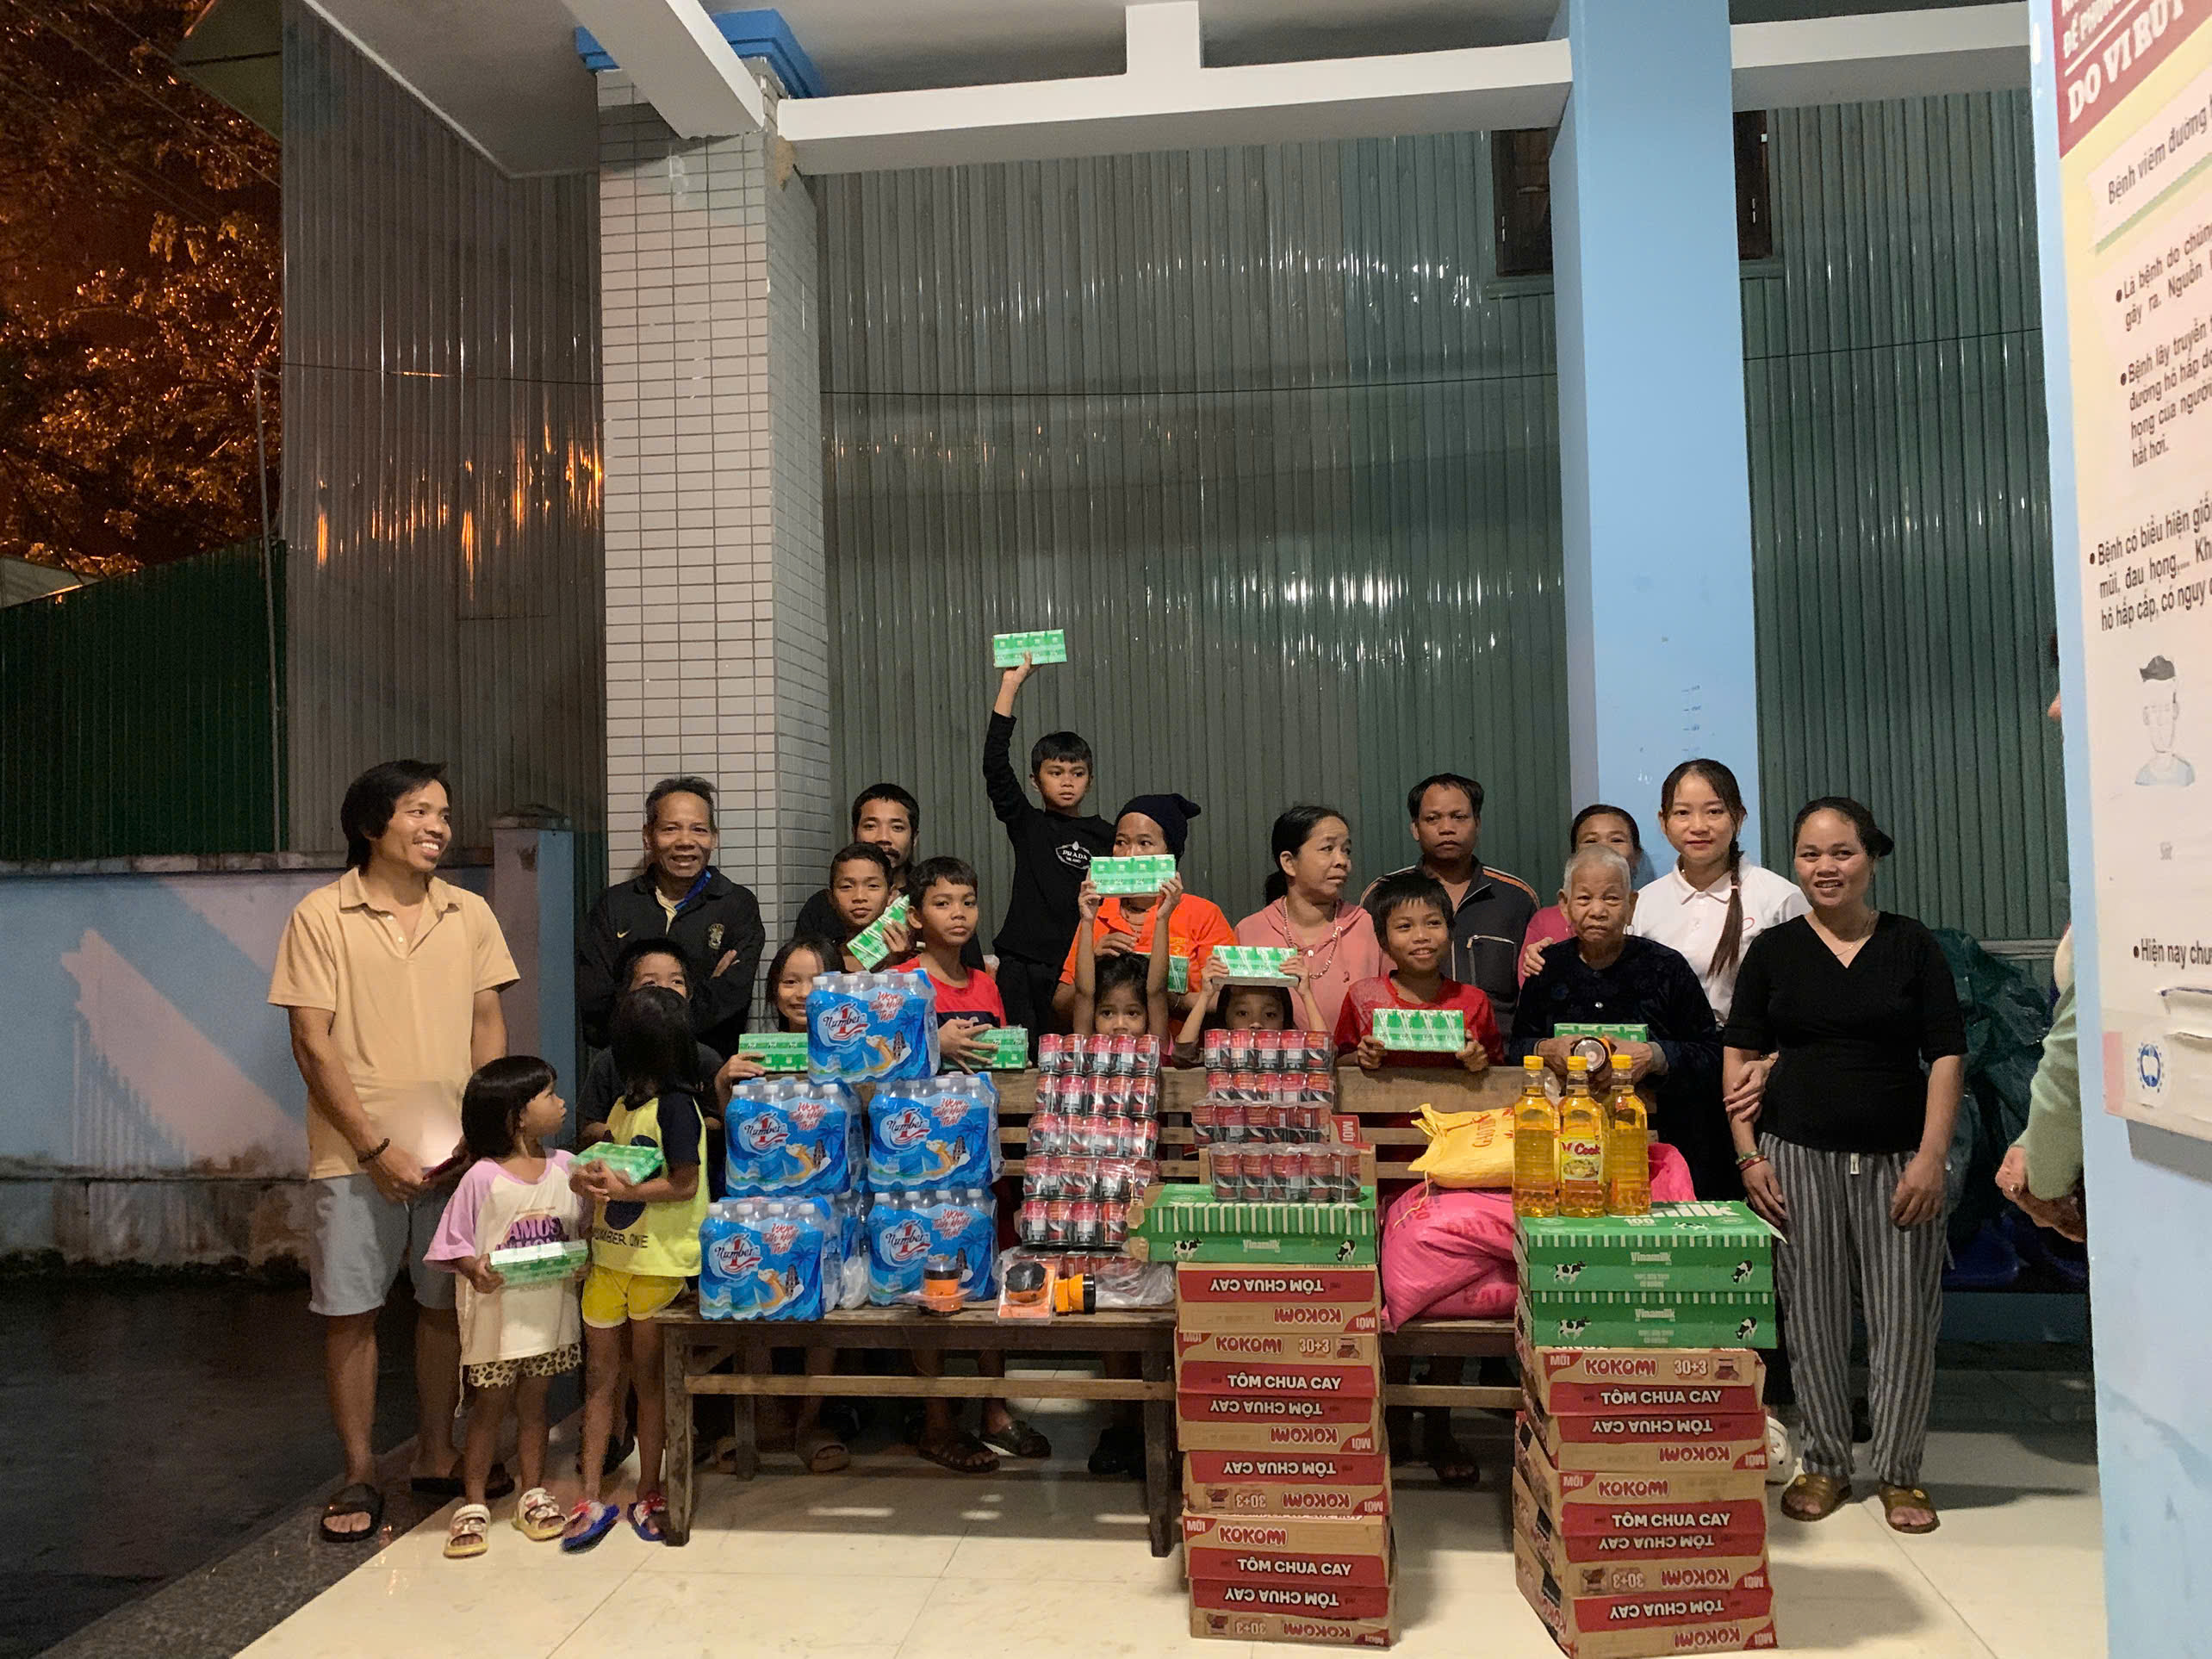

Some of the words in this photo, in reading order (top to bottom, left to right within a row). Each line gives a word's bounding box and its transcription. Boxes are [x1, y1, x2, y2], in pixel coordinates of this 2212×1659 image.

[2067, 63, 2102, 123] DO
[2103, 28, 2132, 84] VI
[2109, 165, 2136, 205] Bệnh
[2137, 143, 2166, 179] viêm
[2123, 276, 2135, 299] Là
[2138, 257, 2164, 289] bệnh
[2166, 246, 2180, 269] do
[2125, 303, 2142, 332] gây
[2148, 294, 2162, 312] ra.
[2167, 258, 2203, 298] Nguồn
[2128, 352, 2153, 384] Bệnh
[2172, 317, 2207, 358] truyền
[2129, 382, 2162, 412] đường
[2164, 366, 2178, 392] hô
[2149, 433, 2170, 459] hơi.
[2097, 535, 2123, 569] Bệnh
[2125, 527, 2138, 555] có
[2140, 514, 2163, 549] biểu
[2165, 509, 2190, 540] hiện
[2125, 565, 2144, 590] đau
[2101, 606, 2114, 631] hô
[2116, 594, 2134, 630] hấp
[2136, 587, 2159, 622] cấp,
[2161, 583, 2175, 612] có
[2178, 579, 2206, 612] nguy
[1062, 849, 1088, 861] PRADA
[2141, 938, 2165, 967] Hiện
[2167, 943, 2187, 970] nay
[823, 1011, 861, 1029] Number
[744, 1121, 780, 1136] Number
[886, 1117, 923, 1132] Number
[885, 1229, 923, 1246] Number
[714, 1243, 753, 1260] Number
[1631, 1252, 1672, 1264] Vinamilk
[1210, 1278, 1241, 1291] CAY
[1244, 1278, 1288, 1292] CHUA
[1289, 1278, 1324, 1296] TÔM
[1274, 1308, 1343, 1324] KOKOMI
[1635, 1308, 1675, 1320] Vinamilk
[1215, 1336, 1283, 1355] KOKOMI
[1299, 1338, 1331, 1354] 30+3
[1584, 1358, 1658, 1376] KOKOMI
[1674, 1358, 1708, 1376] 30+3
[1227, 1372, 1262, 1388] TÔM
[1264, 1375, 1308, 1389] CHUA
[1311, 1376, 1341, 1390] CAY
[1600, 1389, 1637, 1405] TÔM
[1639, 1389, 1687, 1404] CHUA
[1689, 1389, 1722, 1403] CAY
[1210, 1400, 1240, 1413] CAY
[1243, 1401, 1287, 1414] CHUA
[1289, 1402, 1323, 1419] TÔM
[1592, 1420, 1625, 1433] CAY
[1630, 1420, 1674, 1433] CHUA
[1676, 1419, 1713, 1435] TÔM
[1270, 1426, 1338, 1445] KOKOMI
[1659, 1446, 1730, 1463] KOKOMI
[1223, 1461, 1253, 1474] CAY
[1257, 1461, 1300, 1474] CHUA
[1302, 1462, 1337, 1478] TÔM
[1598, 1480, 1669, 1498] KOKOMI
[1235, 1494, 1266, 1508] 30+3
[1283, 1492, 1351, 1510] KOKOMI
[1612, 1511, 1648, 1527] TÔM
[1650, 1513, 1696, 1527] CHUA
[1699, 1513, 1730, 1526] CAY
[1218, 1525, 1288, 1545] KOKOMI
[1634, 1536, 1677, 1550] CHUA
[1680, 1534, 1715, 1550] TÔM
[1598, 1537, 1631, 1550] CAY
[1237, 1556, 1271, 1572] TÔM
[1274, 1561, 1318, 1575] CHUA
[1320, 1563, 1352, 1576] CAY
[1612, 1572, 1643, 1588] 30+3
[1661, 1568, 1730, 1588] KOKOMI
[1224, 1588, 1255, 1601] CAY
[1258, 1589, 1302, 1605] CHUA
[1304, 1592, 1339, 1609] TÔM
[1610, 1605, 1639, 1619] CAY
[1643, 1601, 1687, 1617] CHUA
[1689, 1600, 1724, 1614] TÔM
[1282, 1621, 1352, 1637] KOKOMI
[1675, 1625, 1742, 1648] KOKOMI
